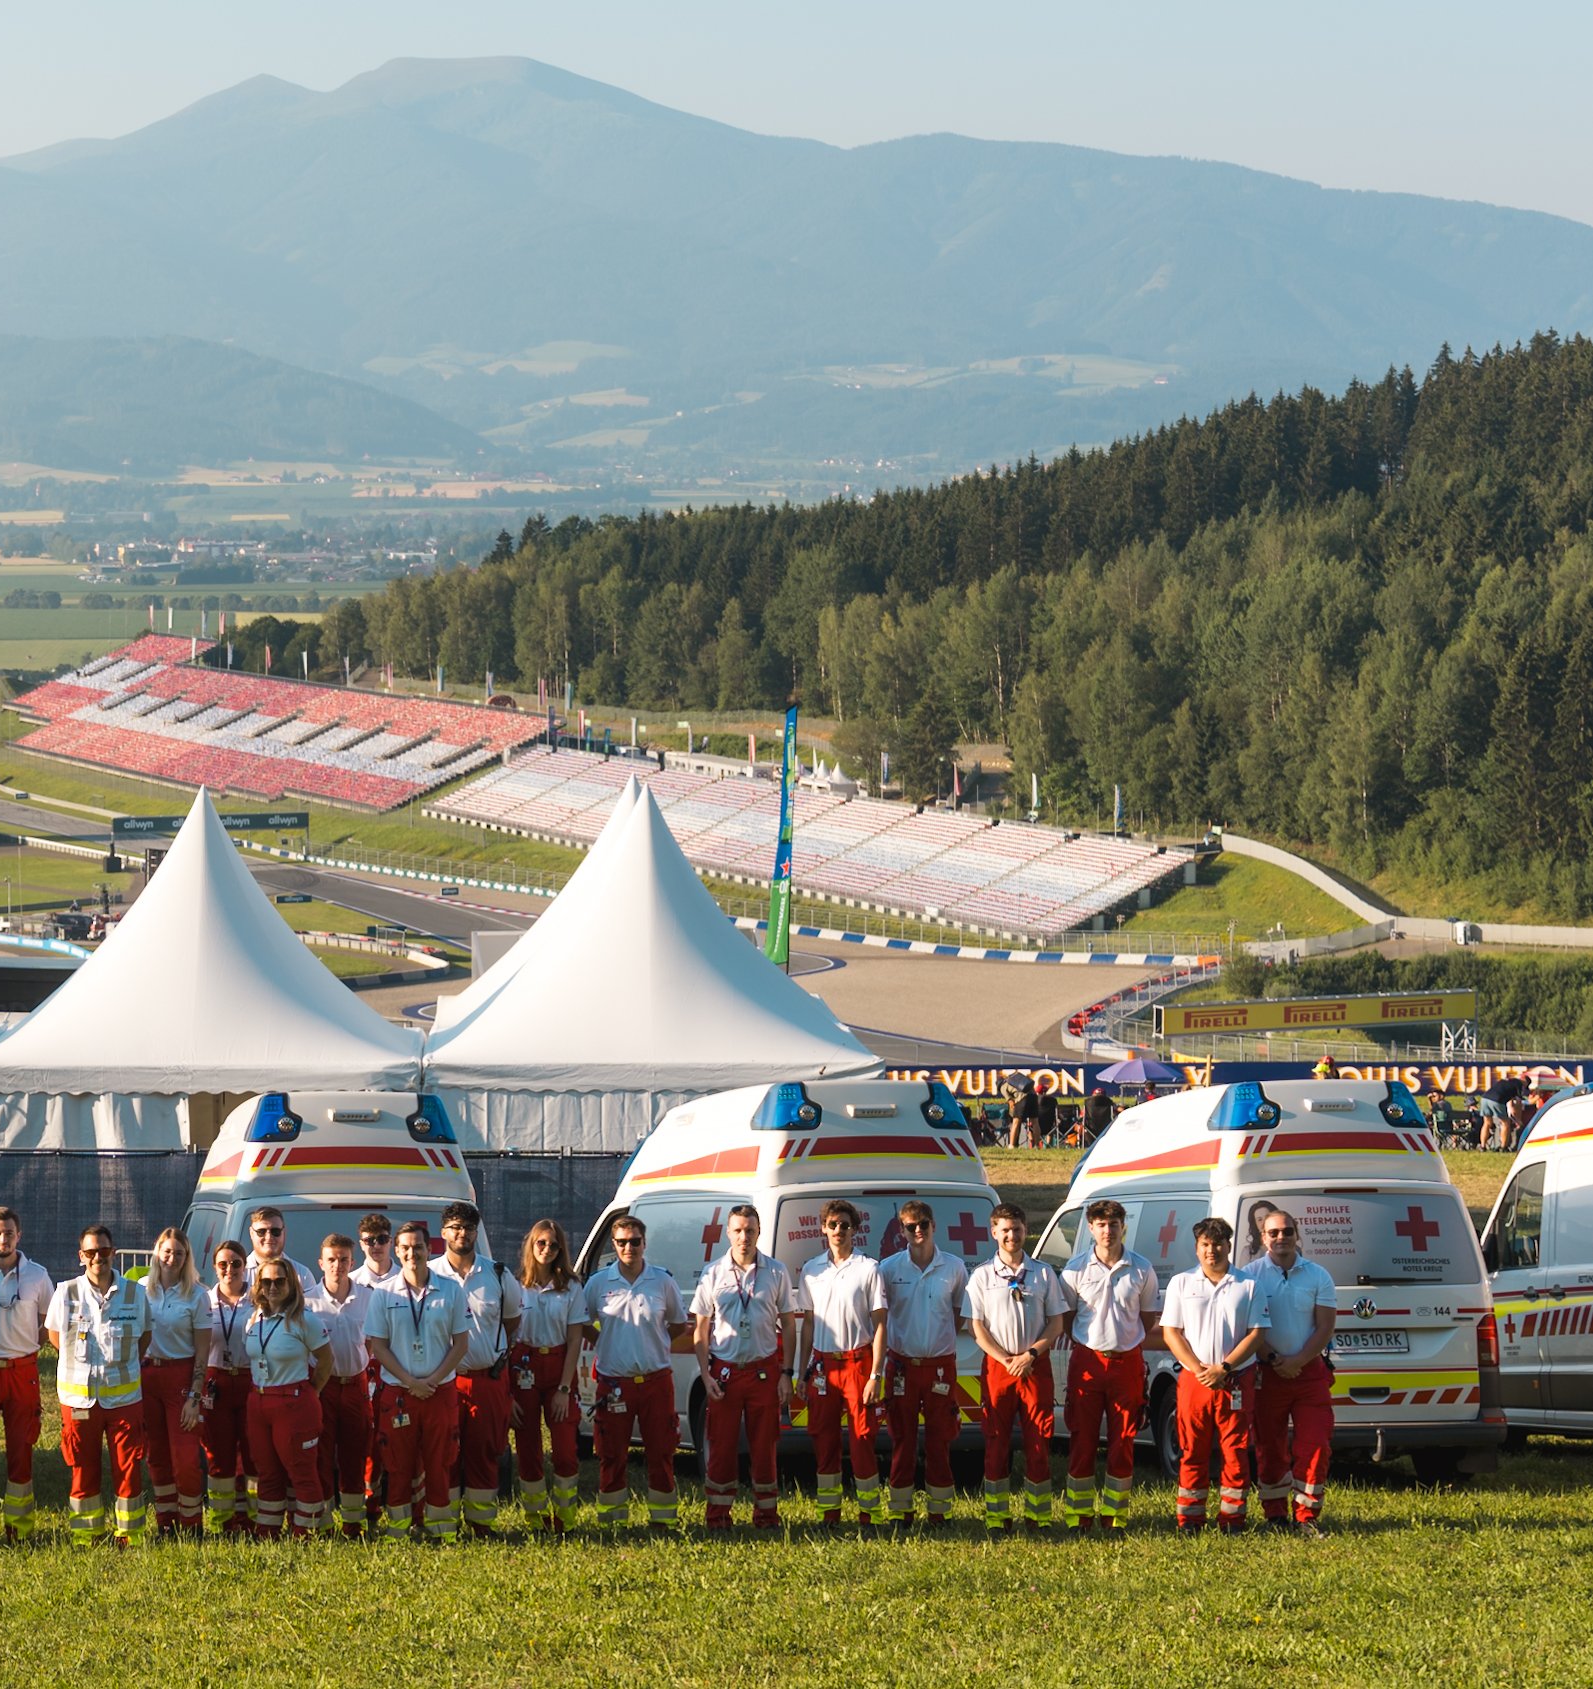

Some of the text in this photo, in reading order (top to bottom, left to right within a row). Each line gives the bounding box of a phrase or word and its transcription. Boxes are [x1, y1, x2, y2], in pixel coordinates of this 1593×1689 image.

[123, 819, 154, 831] allwyn
[268, 815, 298, 826] allwyn
[1183, 998, 1443, 1029] PIRELLI PIRELLI PIRELLI
[1306, 1205, 1351, 1214] RUFHILFE
[798, 1215, 818, 1227] Wir
[1341, 1227, 1353, 1235] auf
[1391, 1257, 1451, 1265] ÖSTERREICHISCHES
[1433, 1306, 1451, 1316] 144
[1336, 1332, 1402, 1347] SO 510 RK
